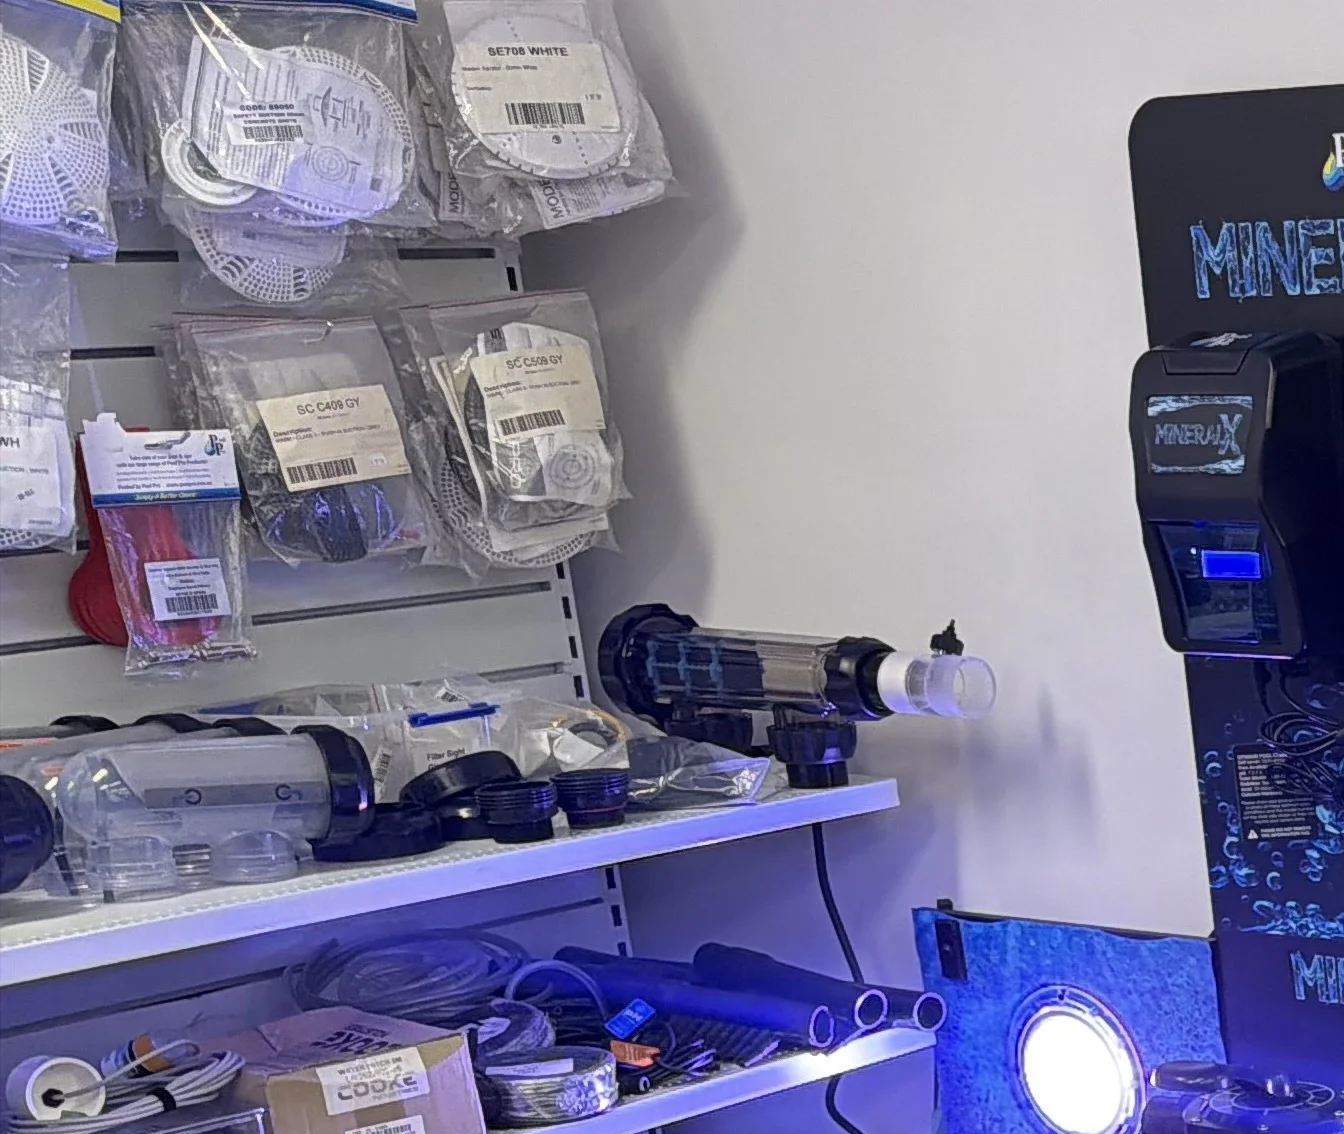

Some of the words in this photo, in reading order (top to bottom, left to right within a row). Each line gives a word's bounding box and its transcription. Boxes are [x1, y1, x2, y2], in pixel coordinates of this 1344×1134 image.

[487, 46, 526, 57] SE708
[528, 46, 569, 57] WHITE
[505, 357, 523, 370] SC
[522, 355, 549, 369] C509
[549, 354, 563, 365] GY
[296, 403, 315, 416] SC
[316, 399, 344, 413] C409
[345, 396, 361, 409] GY
